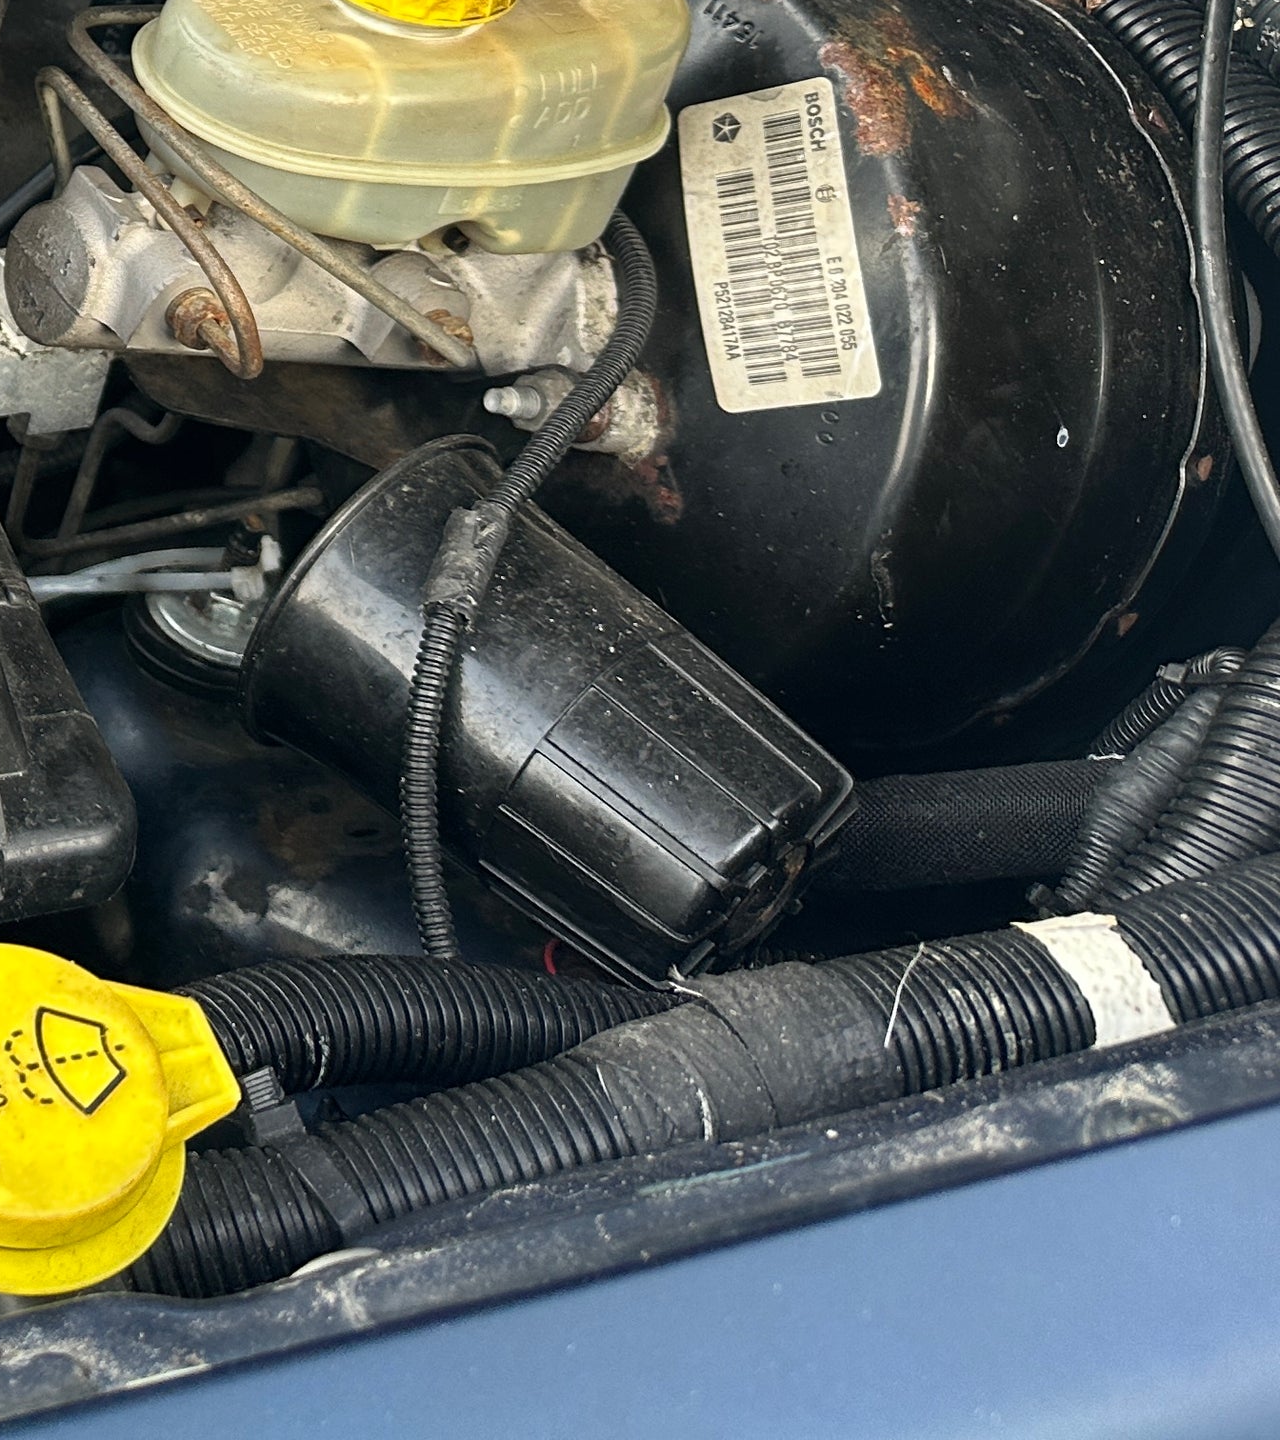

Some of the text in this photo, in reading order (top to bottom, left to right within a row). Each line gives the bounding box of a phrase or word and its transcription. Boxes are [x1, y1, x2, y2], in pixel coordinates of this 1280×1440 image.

[803, 91, 827, 153] BOSCH
[770, 279, 790, 311] 0670
[830, 278, 848, 300] 204
[713, 281, 742, 361] P52128417AA
[834, 304, 853, 325] 022
[840, 329, 858, 350] 055
